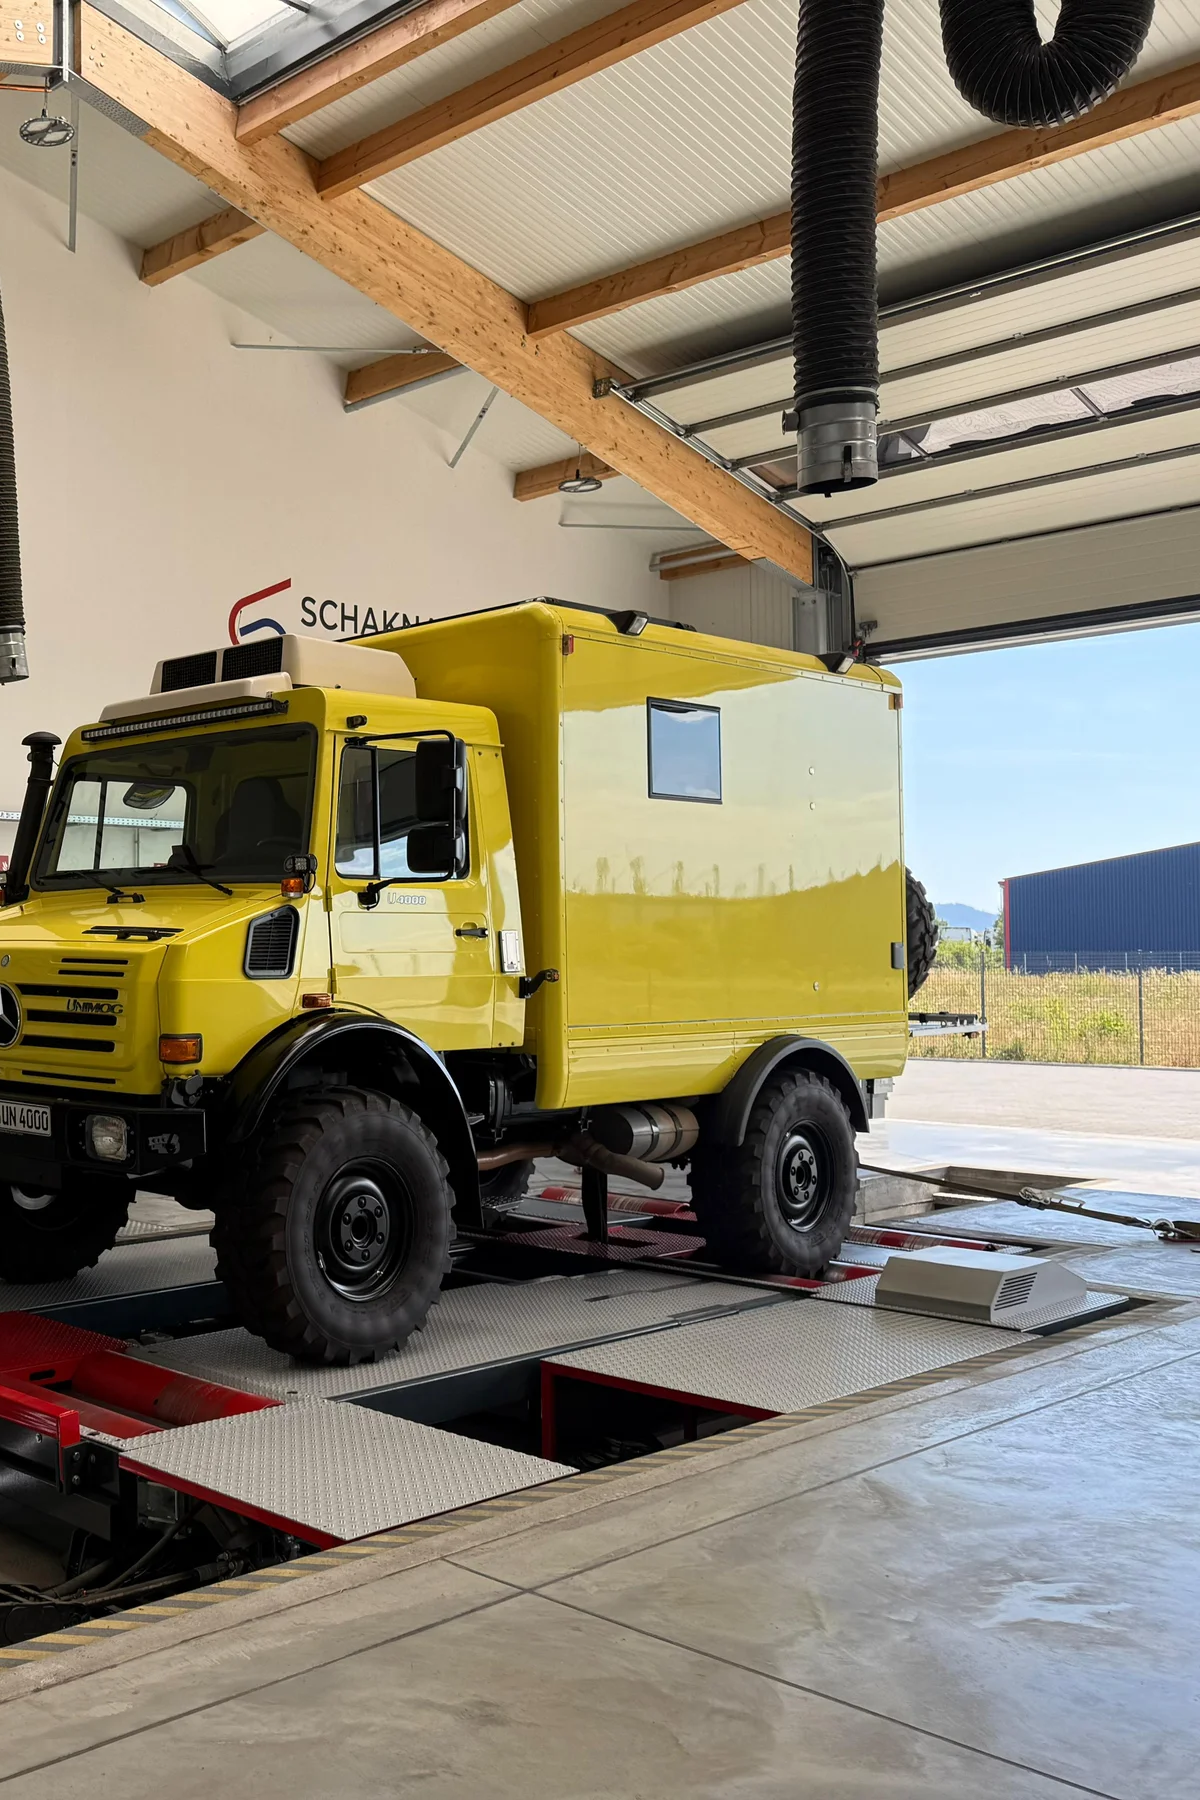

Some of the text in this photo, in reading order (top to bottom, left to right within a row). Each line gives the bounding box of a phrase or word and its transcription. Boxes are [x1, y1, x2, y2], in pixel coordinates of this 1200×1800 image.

[66, 998, 124, 1014] UNIMOG
[1, 1104, 17, 1127] UN
[19, 1107, 49, 1131] 4000
